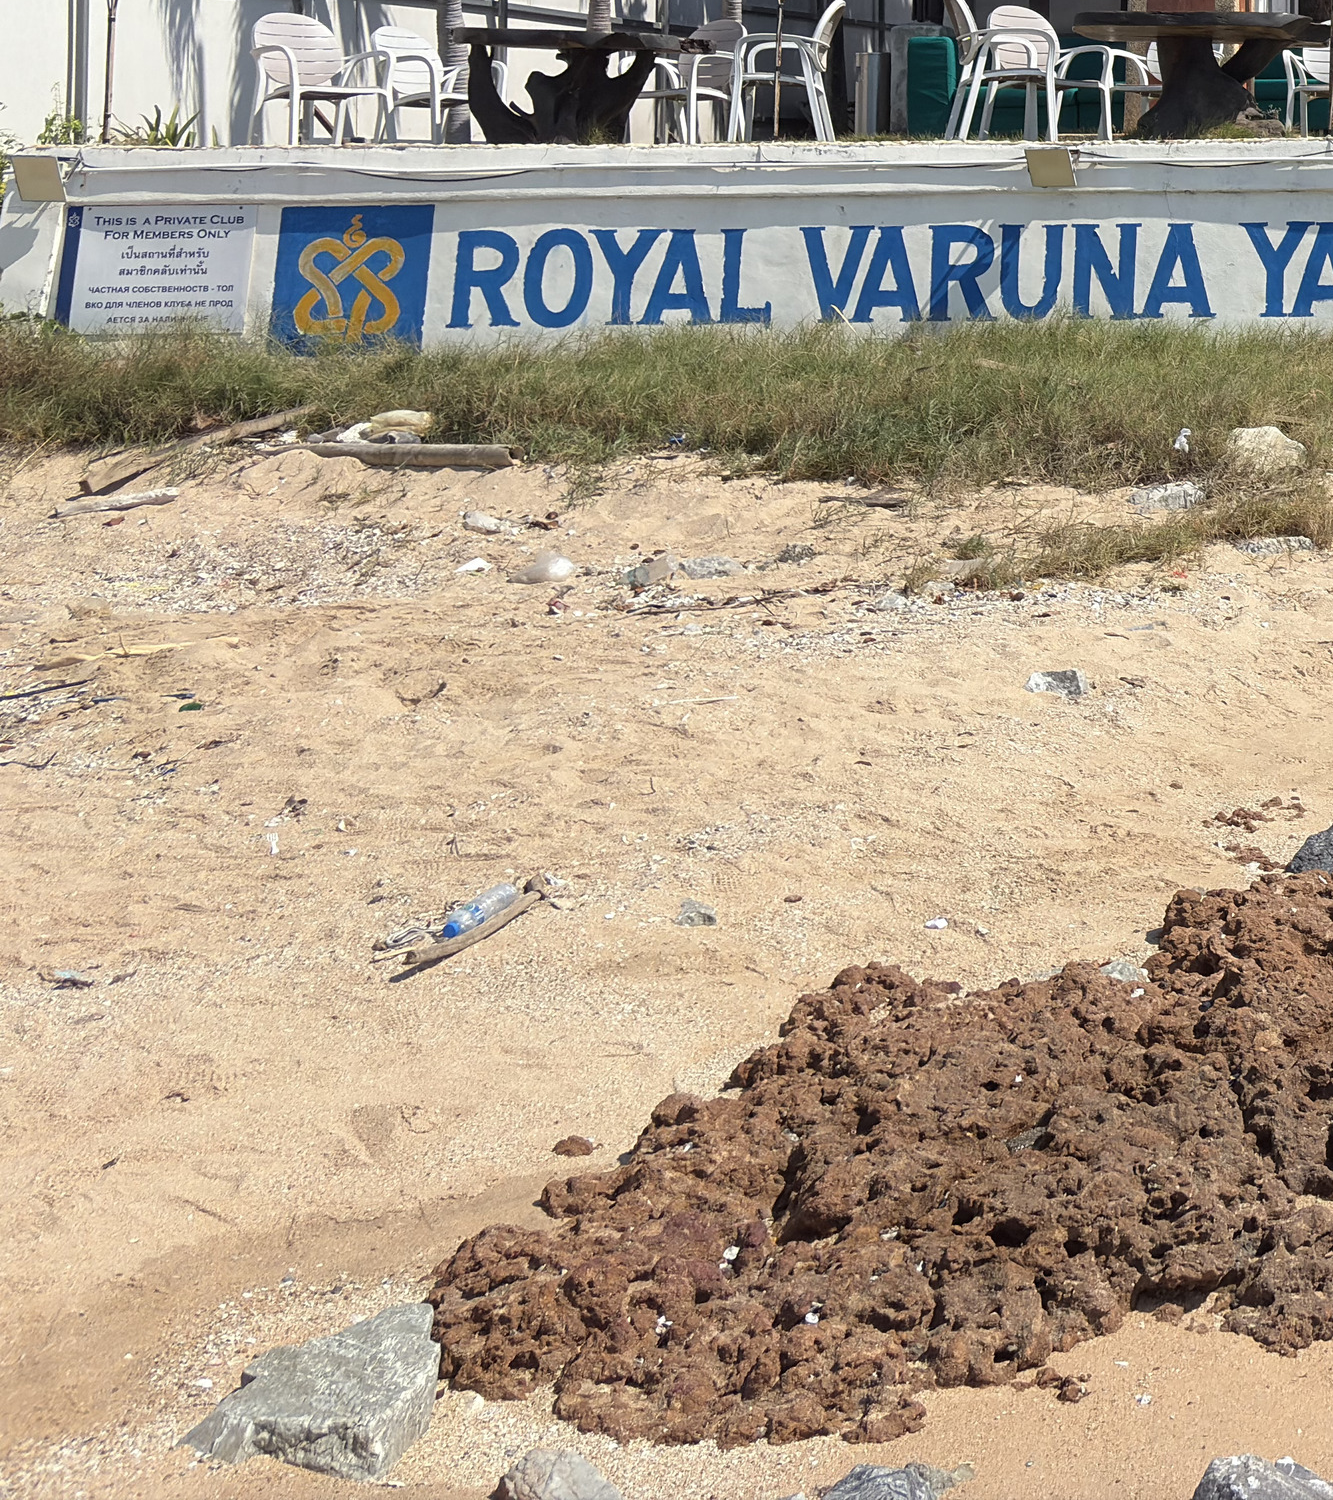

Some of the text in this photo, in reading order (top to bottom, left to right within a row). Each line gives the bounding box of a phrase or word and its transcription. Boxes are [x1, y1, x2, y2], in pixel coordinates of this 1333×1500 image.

[94, 214, 245, 226] THIS IS A PRIVATE CLUB
[104, 228, 231, 240] FOR MEMBERS ONLY
[446, 227, 771, 329] ROYAL
[799, 223, 1217, 323] VARUNA
[88, 285, 130, 294] ЧАСТНАЯ
[216, 284, 234, 292] ТОЛ
[85, 299, 234, 310] ВКО ДЛЯ ЧЛЕНОВ КЛУБА НЕ ПРОД
[106, 316, 136, 324] АЕТСЯ
